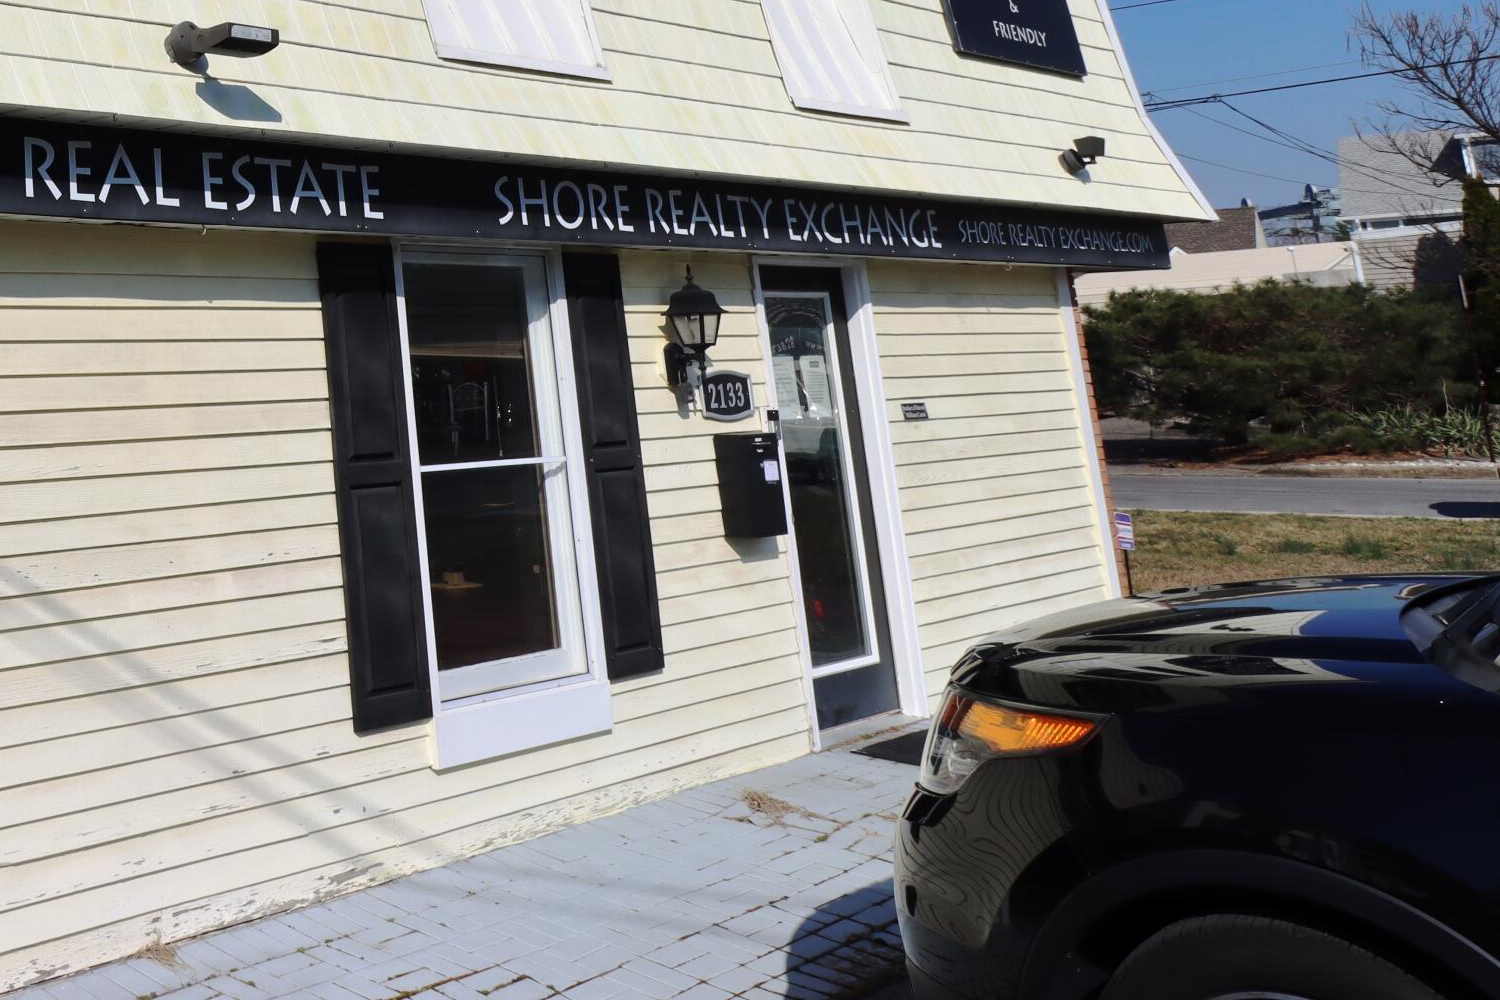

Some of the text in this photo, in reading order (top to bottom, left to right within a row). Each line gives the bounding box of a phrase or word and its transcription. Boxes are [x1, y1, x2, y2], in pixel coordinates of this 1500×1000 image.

[993, 21, 1046, 47] FRIENDLY
[23, 136, 384, 220] REAL ESTATE
[494, 175, 942, 249] SHORE REALTY EXCHANGE
[958, 220, 1006, 245] SHORE
[1008, 224, 1057, 247] REALTY
[708, 382, 744, 409] 2133
